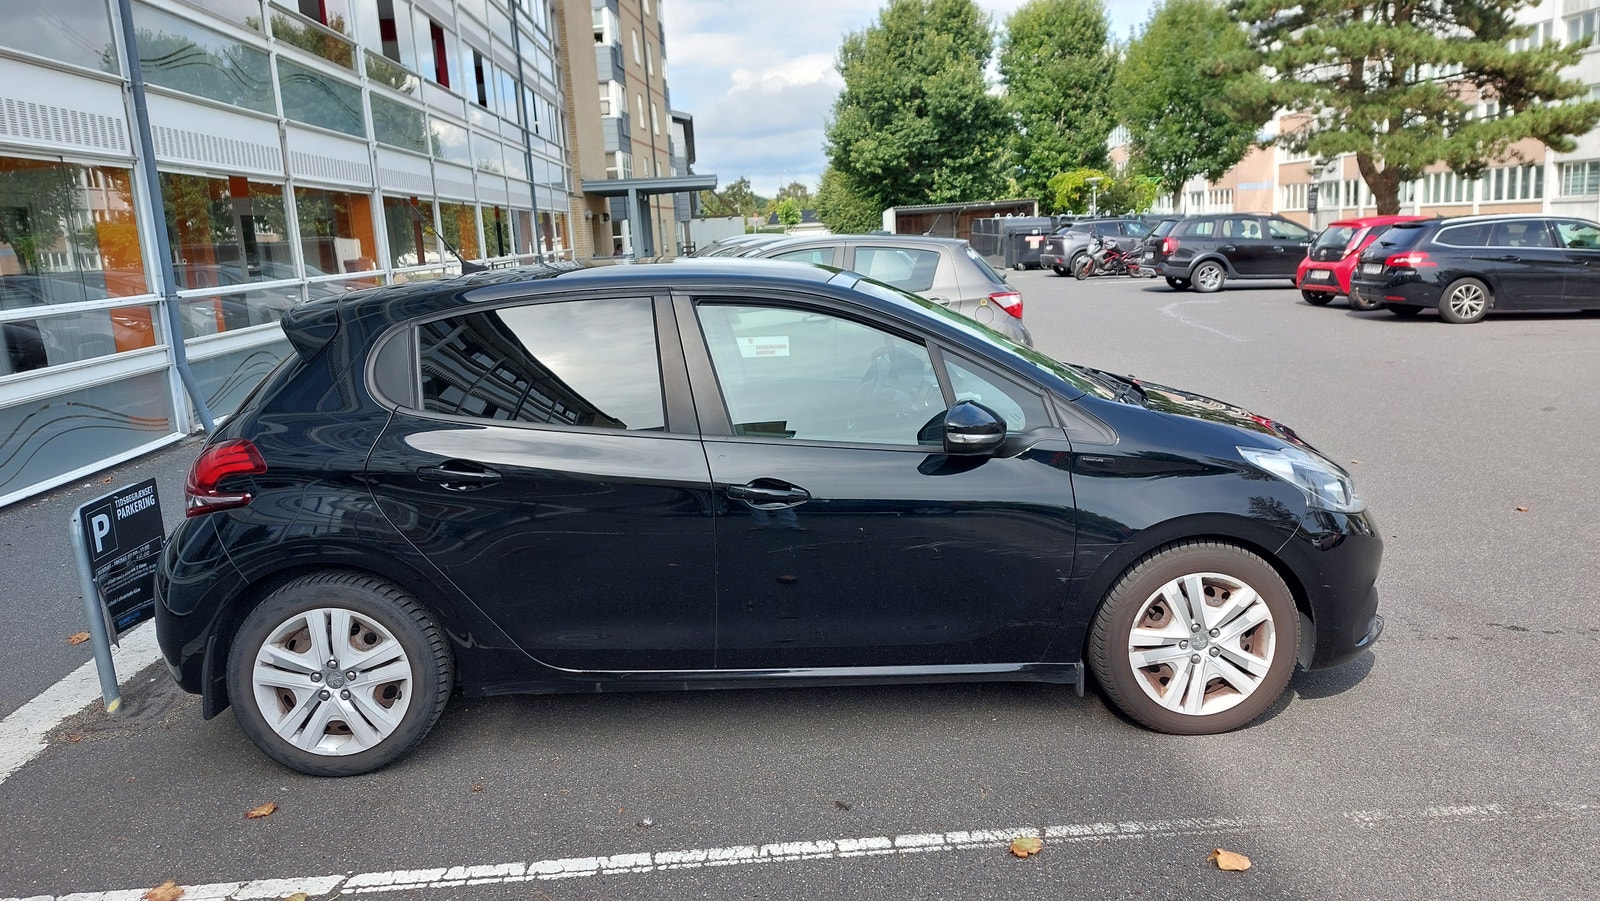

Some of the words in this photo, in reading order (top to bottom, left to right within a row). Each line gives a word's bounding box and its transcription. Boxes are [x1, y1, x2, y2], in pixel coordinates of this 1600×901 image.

[114, 485, 153, 508] TIDSBEGRÆNSET
[116, 494, 156, 521] PARKERING
[91, 513, 110, 553] P
